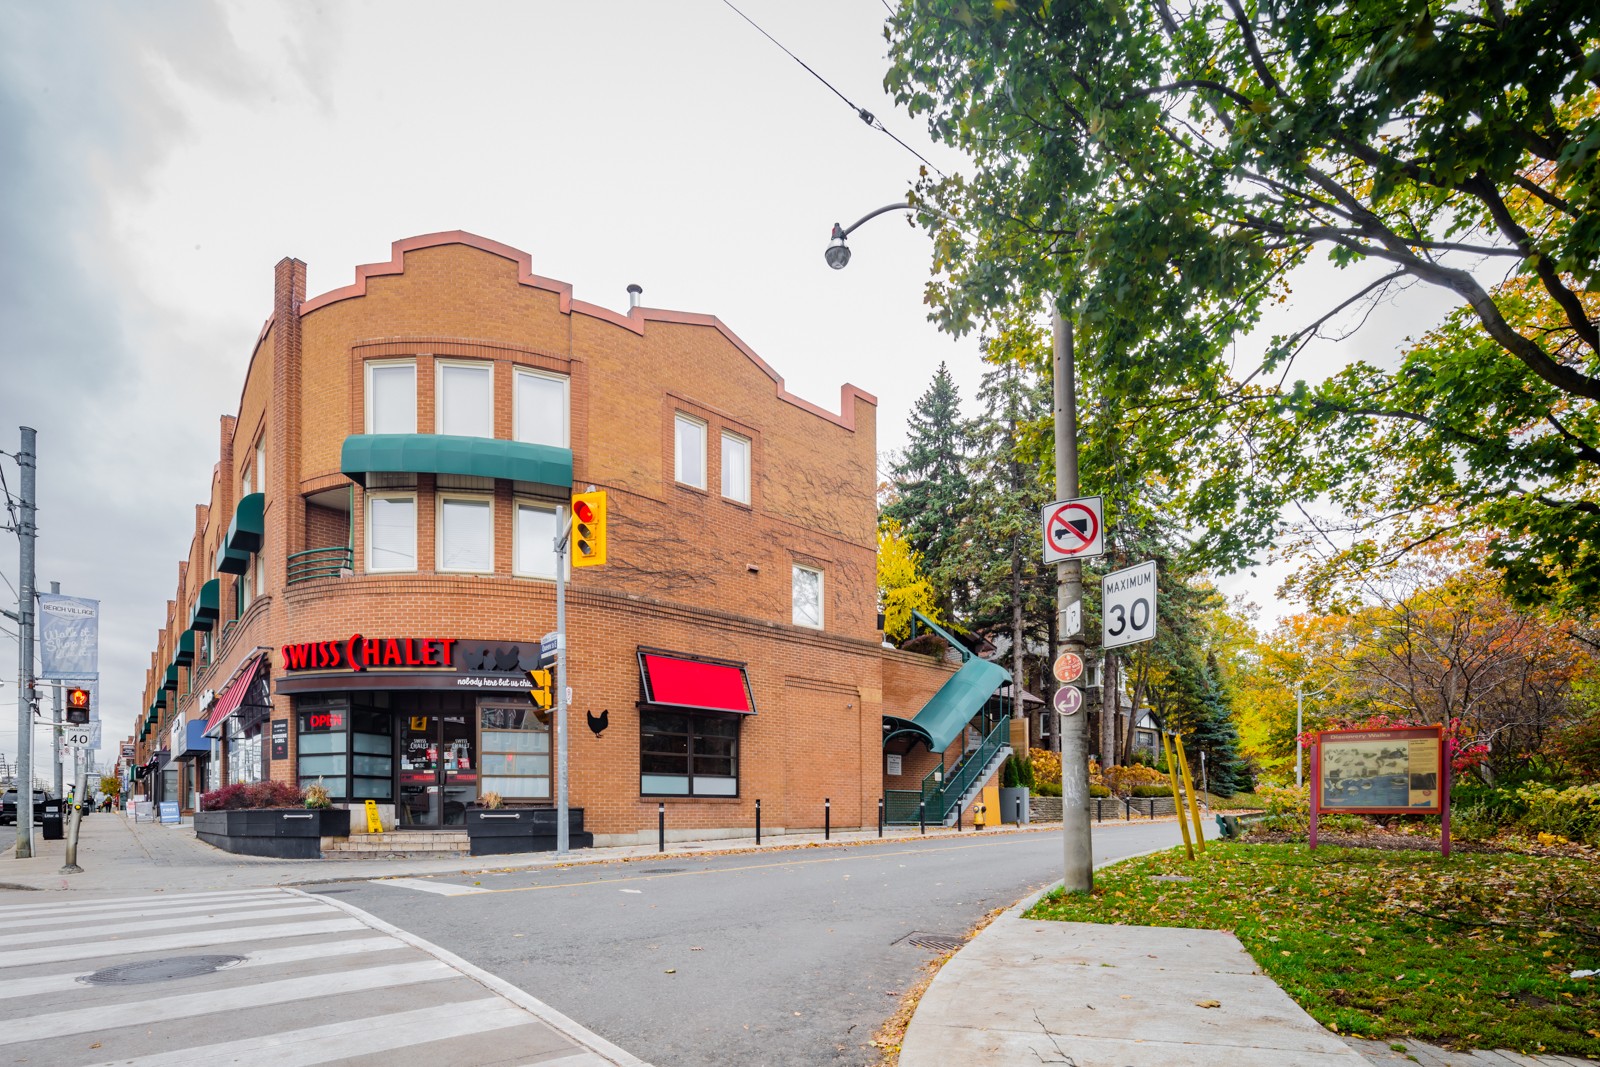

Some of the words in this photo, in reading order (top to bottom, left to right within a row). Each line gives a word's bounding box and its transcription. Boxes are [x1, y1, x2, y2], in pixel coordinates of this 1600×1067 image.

[1106, 572, 1151, 595] MAXIMUM
[43, 604, 67, 612] BEACH
[67, 607, 95, 616] VILLAGE
[1108, 597, 1150, 637] 30
[281, 640, 341, 671] SWISS
[346, 633, 457, 671] CHALET
[457, 677, 483, 687] nobody
[483, 678, 498, 686] here
[498, 678, 511, 687] but
[310, 713, 342, 727] OPEN
[70, 734, 88, 744] 40
[1330, 733, 1366, 741] Discovery
